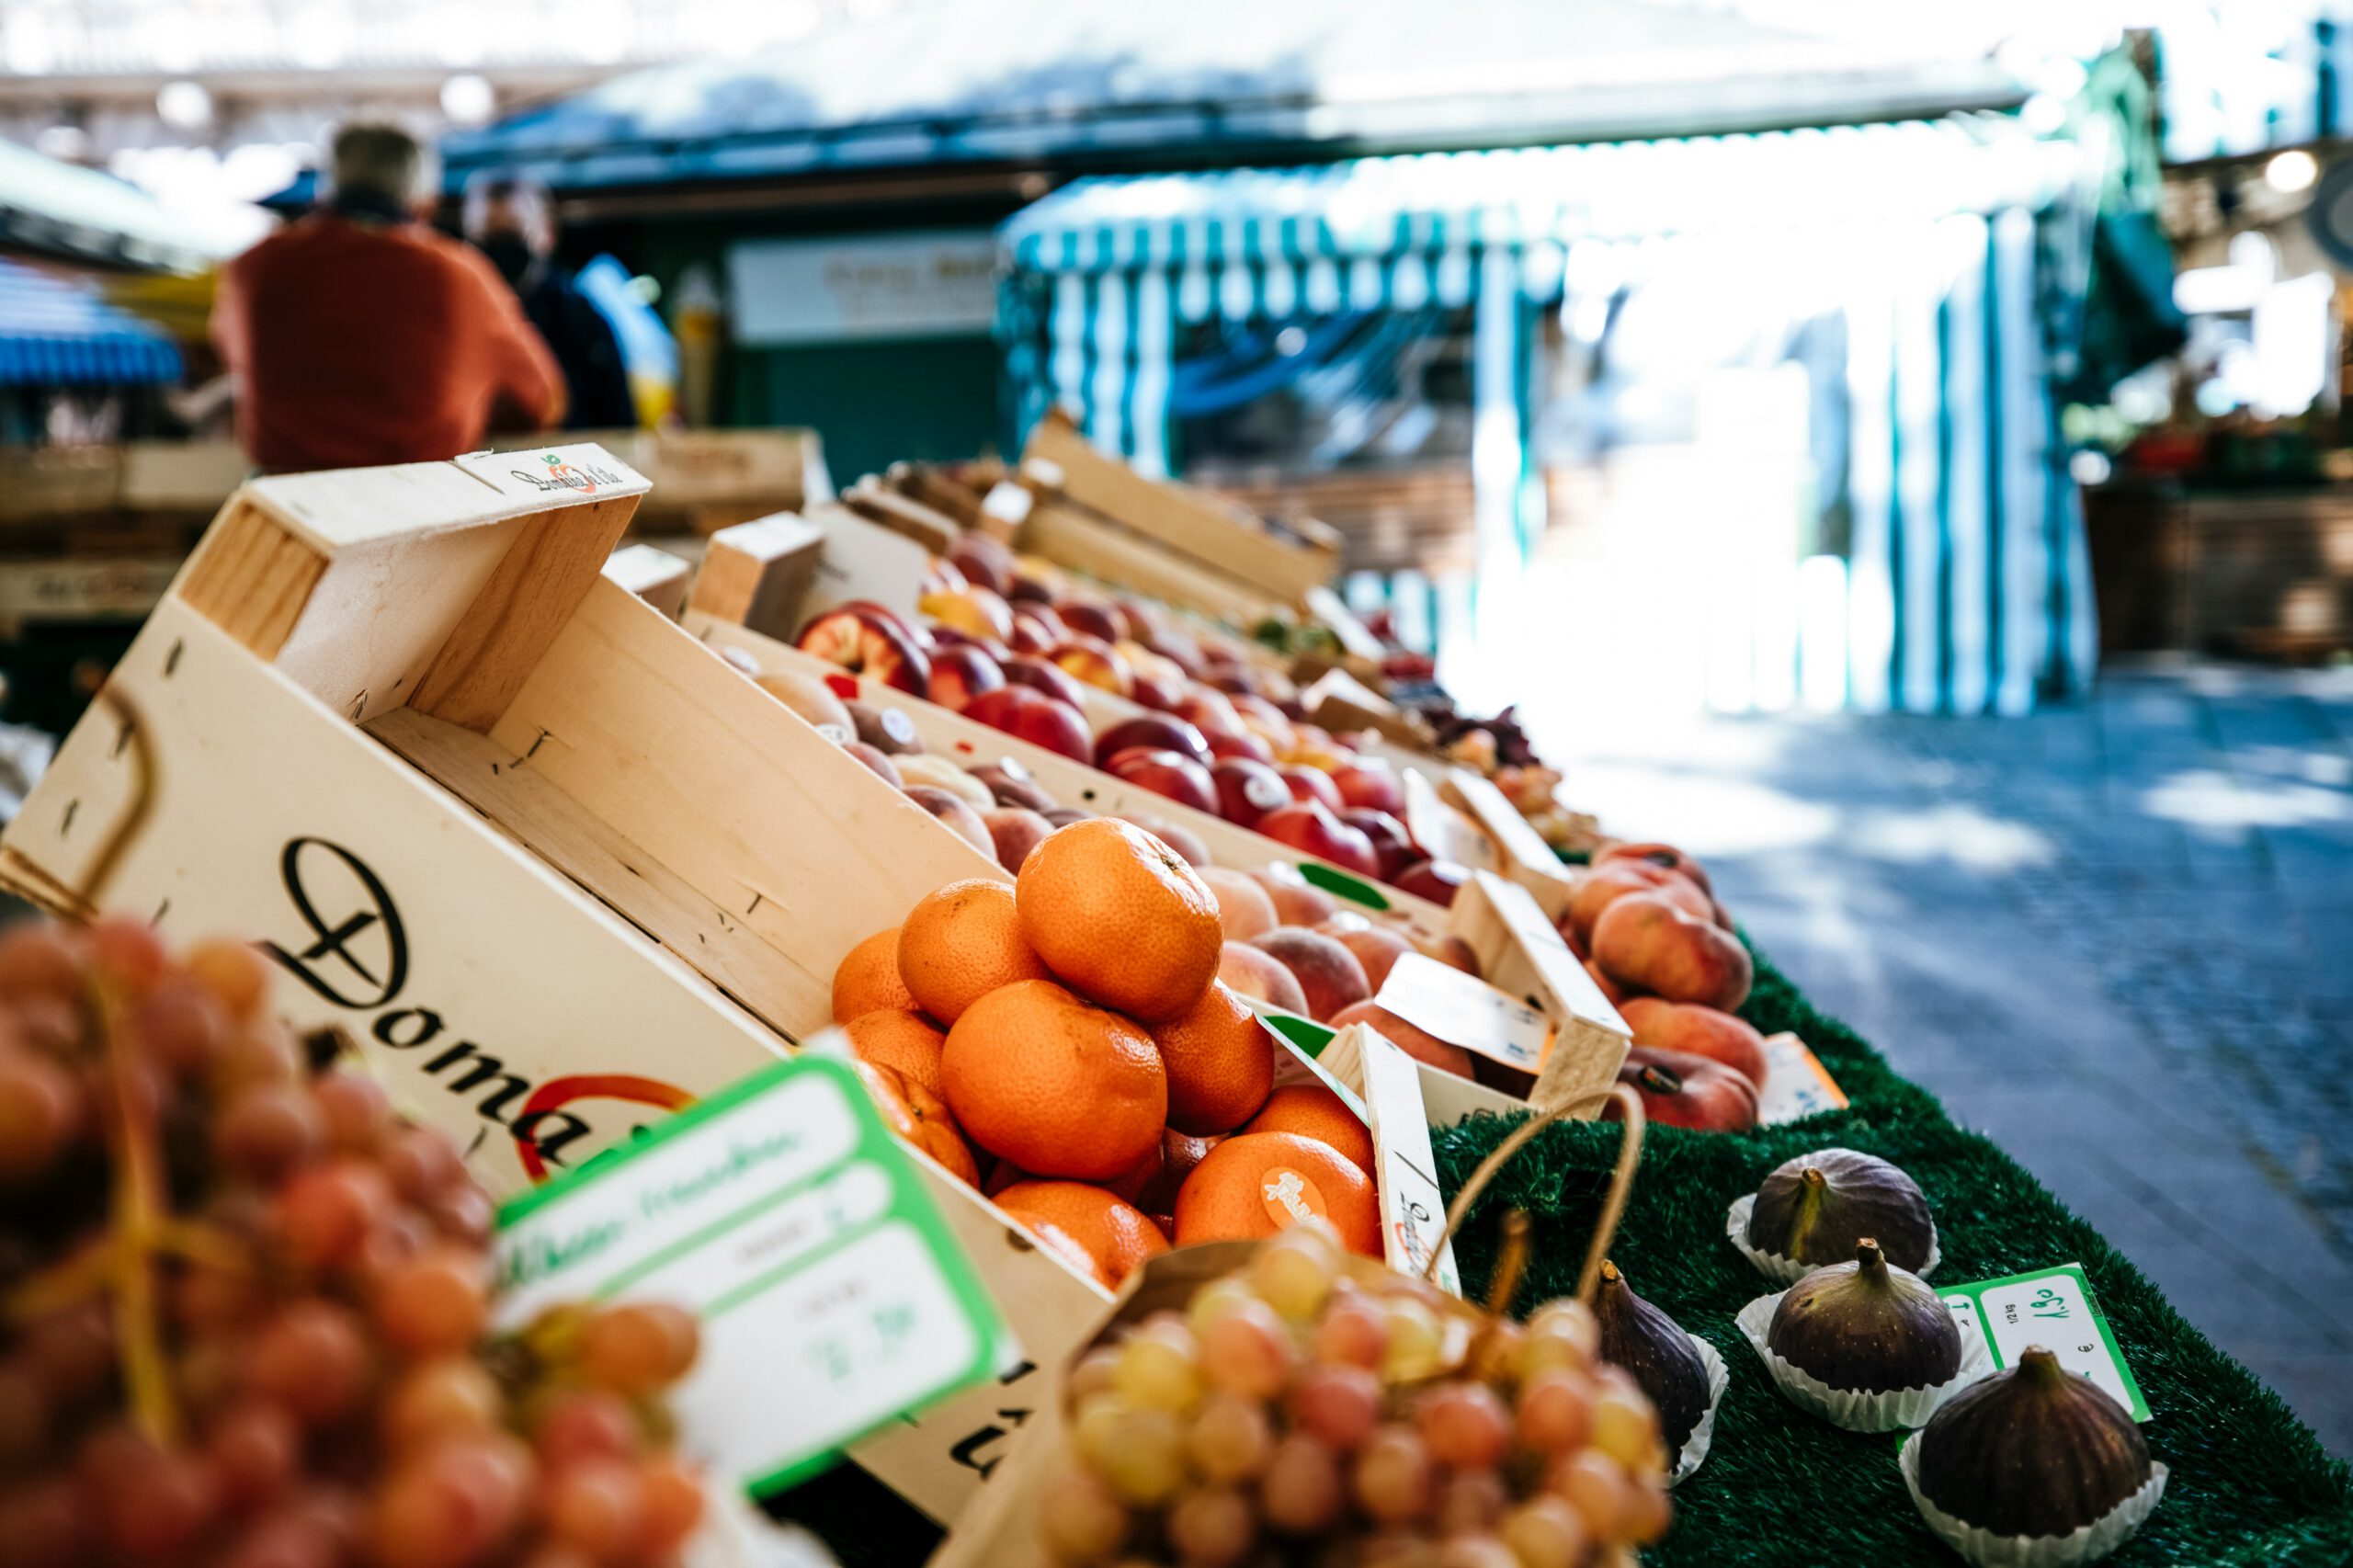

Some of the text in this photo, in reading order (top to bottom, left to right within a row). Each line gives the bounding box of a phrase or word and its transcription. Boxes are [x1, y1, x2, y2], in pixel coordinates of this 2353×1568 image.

[258, 837, 643, 1167] Doma
[2005, 1303, 2019, 1324] 1/2 kg
[2029, 1289, 2071, 1318] 1.90
